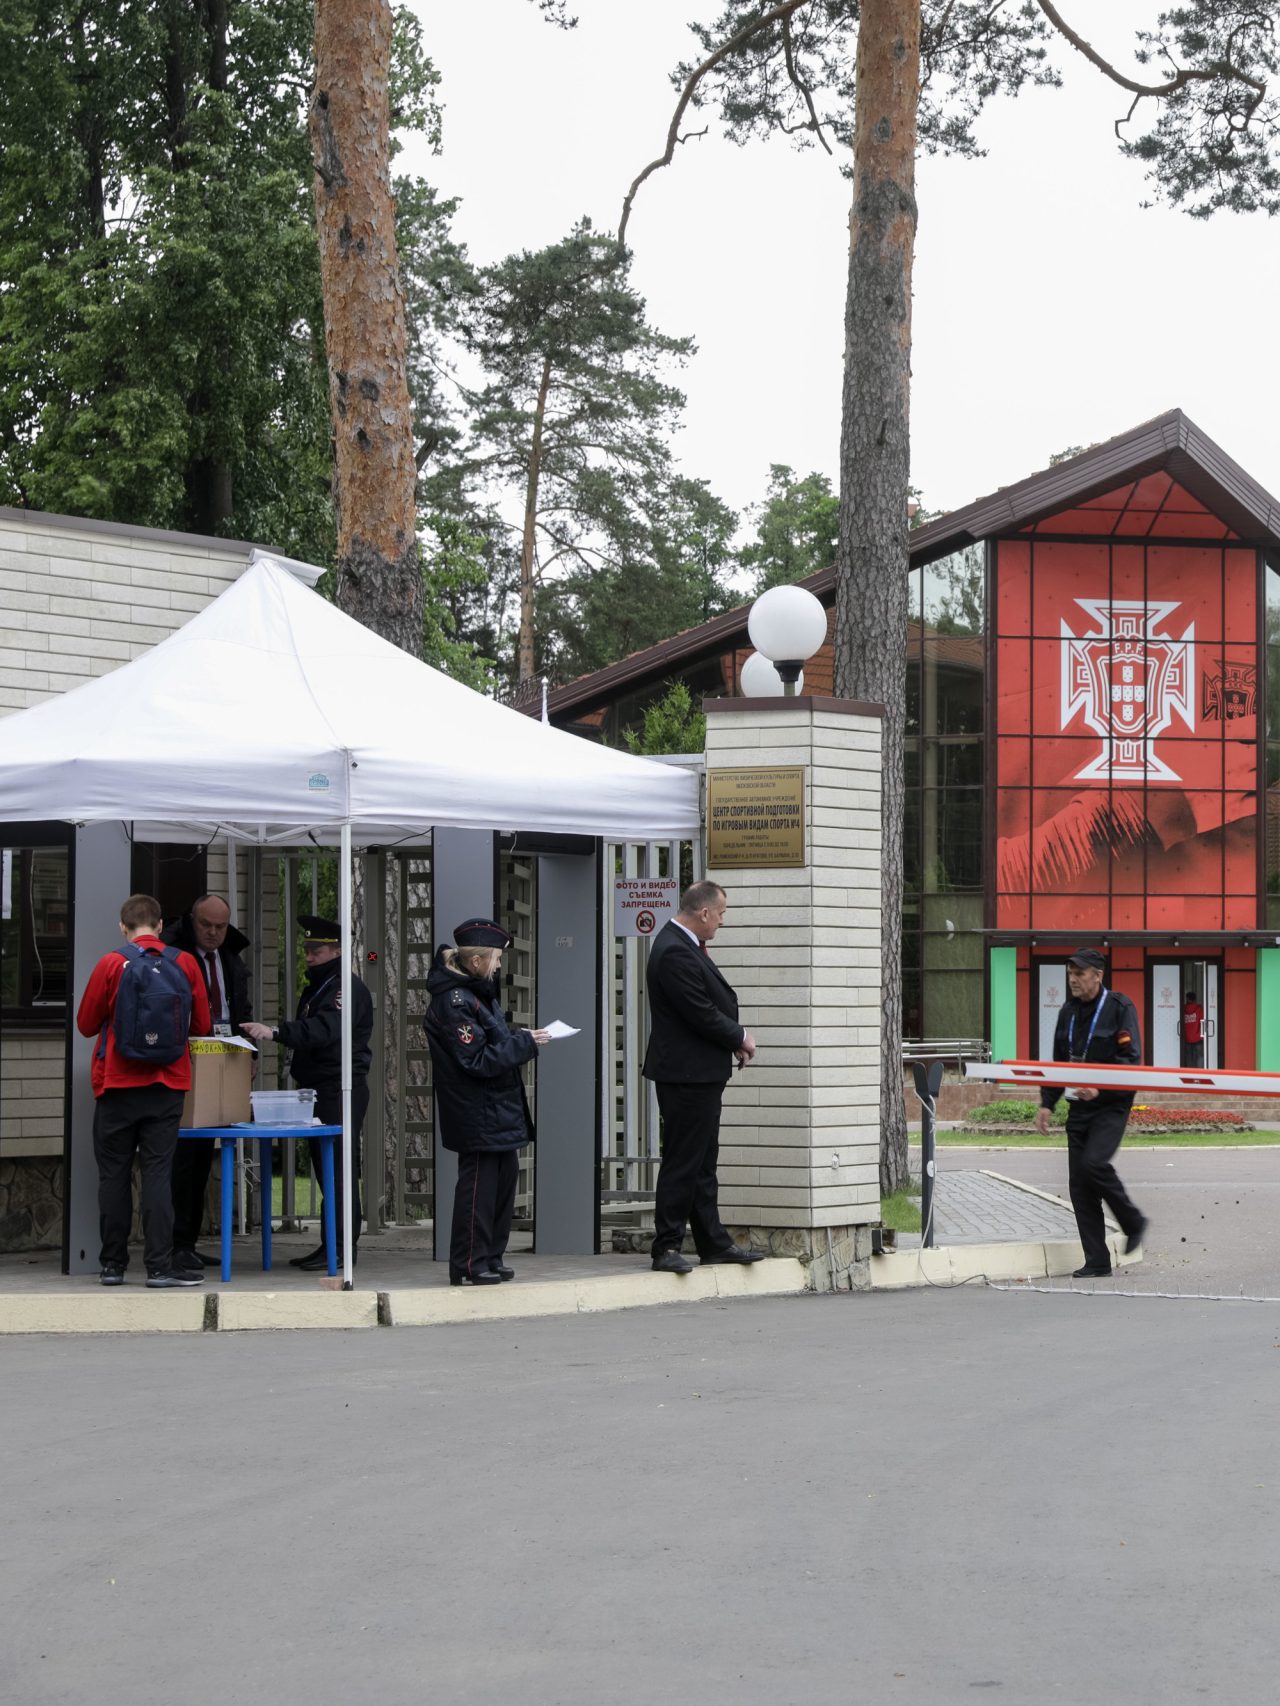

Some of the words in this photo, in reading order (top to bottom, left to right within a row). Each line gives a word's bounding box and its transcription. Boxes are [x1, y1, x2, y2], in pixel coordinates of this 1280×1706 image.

[1114, 642, 1144, 655] F.P.F.
[713, 806, 729, 819] ЦЕНТР
[730, 803, 764, 817] СПОРТИВНОЙ
[766, 804, 800, 818] ПОДГОТОВКИ
[713, 820, 720, 831] ПО
[721, 819, 748, 831] ИГРОВЫМ
[749, 819, 769, 832] ВИДАМ
[770, 818, 790, 830] СПОРТА
[649, 881, 676, 890] ВИДЕО
[629, 891, 663, 899] СЪЕМКА
[621, 900, 671, 909] ЗАПРЕЩЕНА
